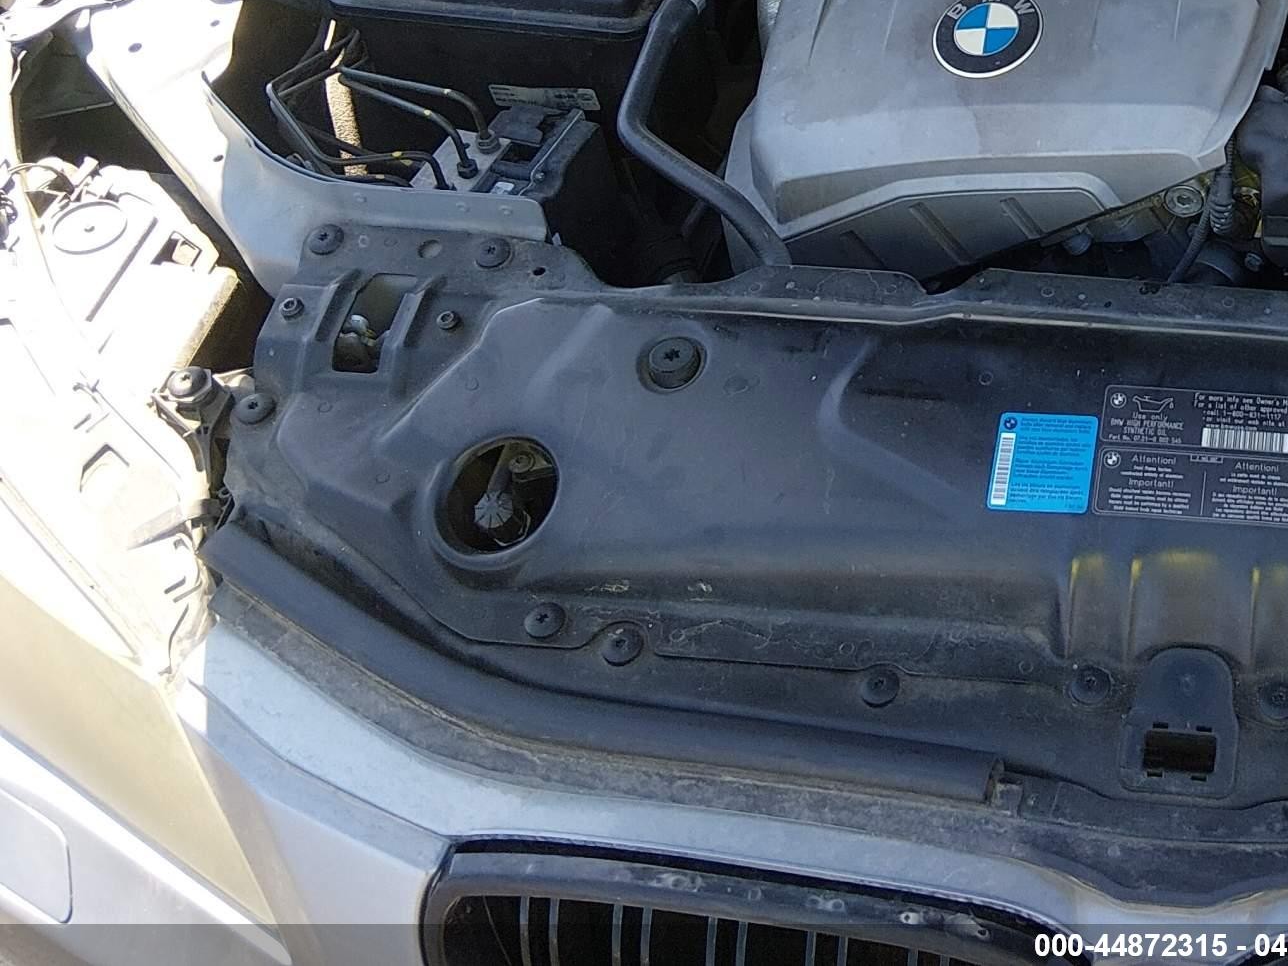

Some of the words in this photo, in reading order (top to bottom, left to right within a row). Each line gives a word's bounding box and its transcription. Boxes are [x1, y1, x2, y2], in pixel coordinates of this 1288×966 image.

[1256, 397, 1280, 406] Owner's
[1194, 400, 1204, 408] For
[1240, 403, 1256, 411] other
[1260, 405, 1287, 414] approved
[1151, 413, 1168, 421] only
[1110, 418, 1124, 426] BMW
[1143, 420, 1184, 430] PERFORMANCE
[1131, 454, 1176, 465] Attention!
[1235, 462, 1279, 472] Attention!
[1129, 478, 1174, 488] Important!
[1233, 485, 1277, 496] Important!
